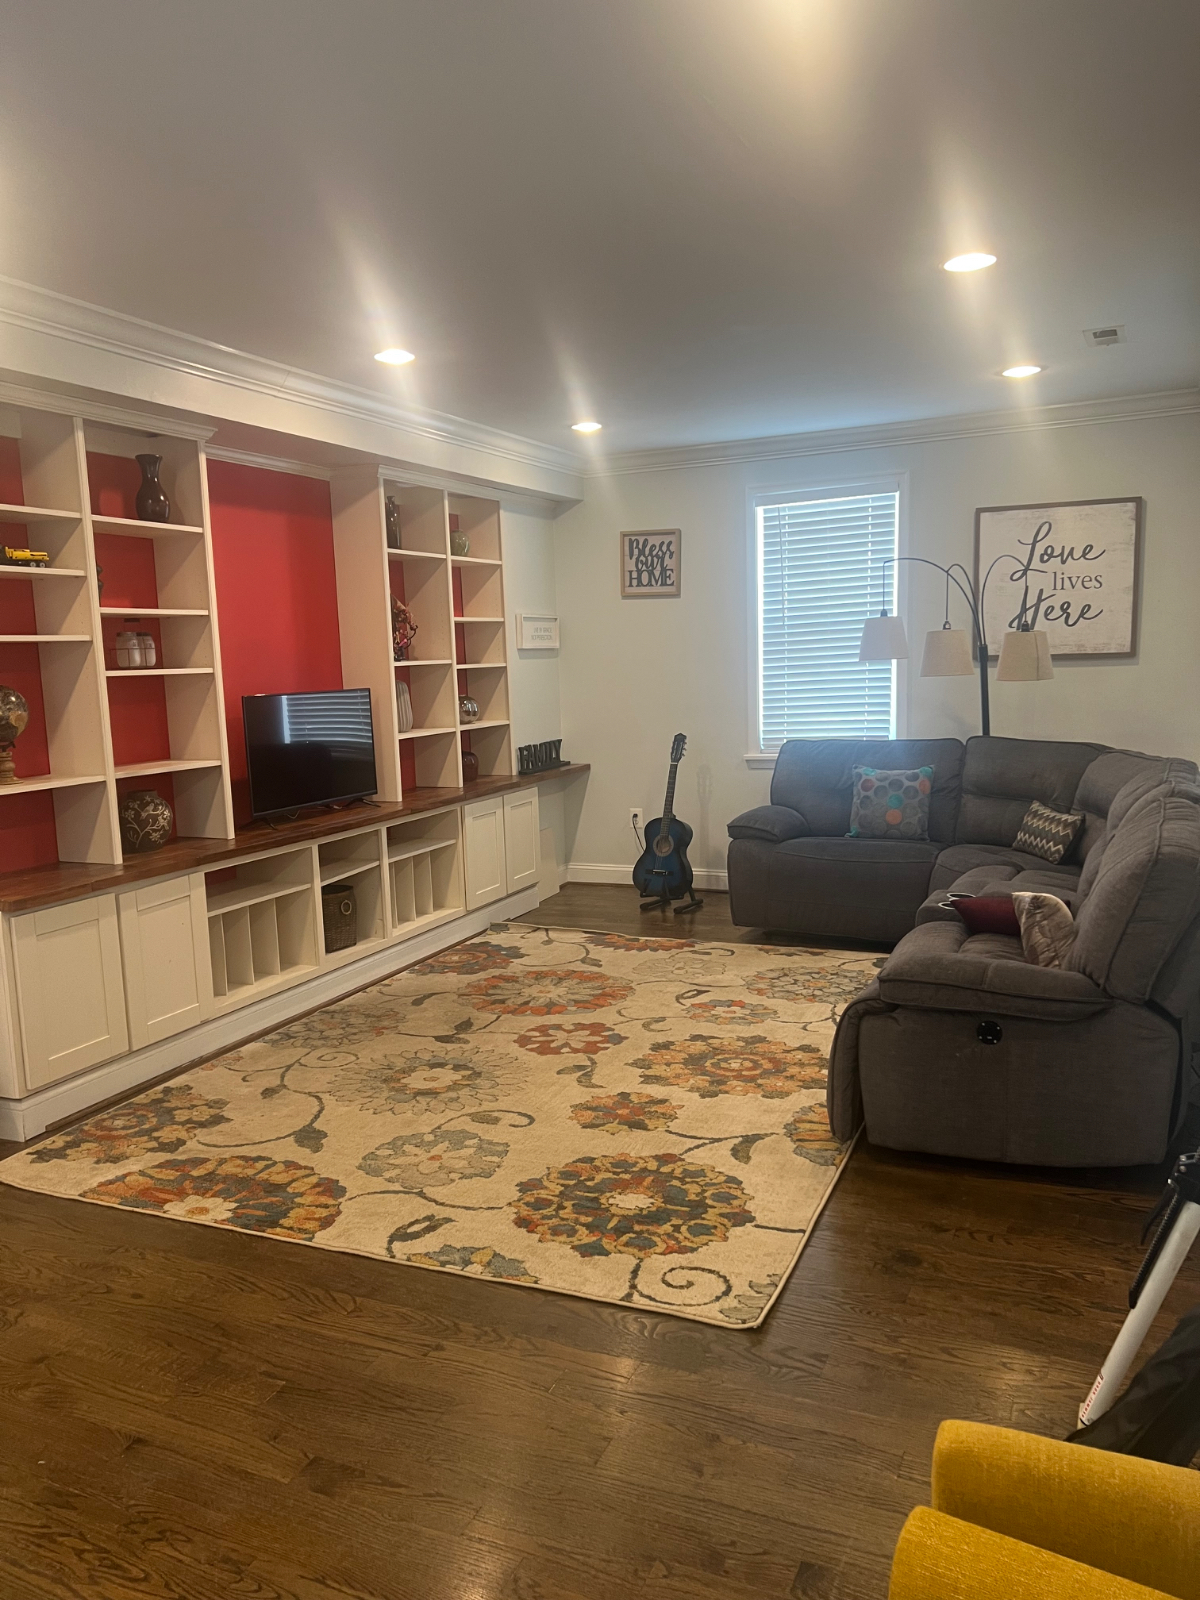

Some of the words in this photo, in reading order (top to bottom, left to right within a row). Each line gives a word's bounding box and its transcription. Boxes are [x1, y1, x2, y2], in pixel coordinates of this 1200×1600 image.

[629, 537, 674, 560] Bless
[1010, 521, 1106, 581] Love
[628, 569, 674, 587] HOME
[1052, 571, 1103, 590] lives
[1008, 585, 1103, 630] Here
[518, 739, 562, 771] FAMILY
